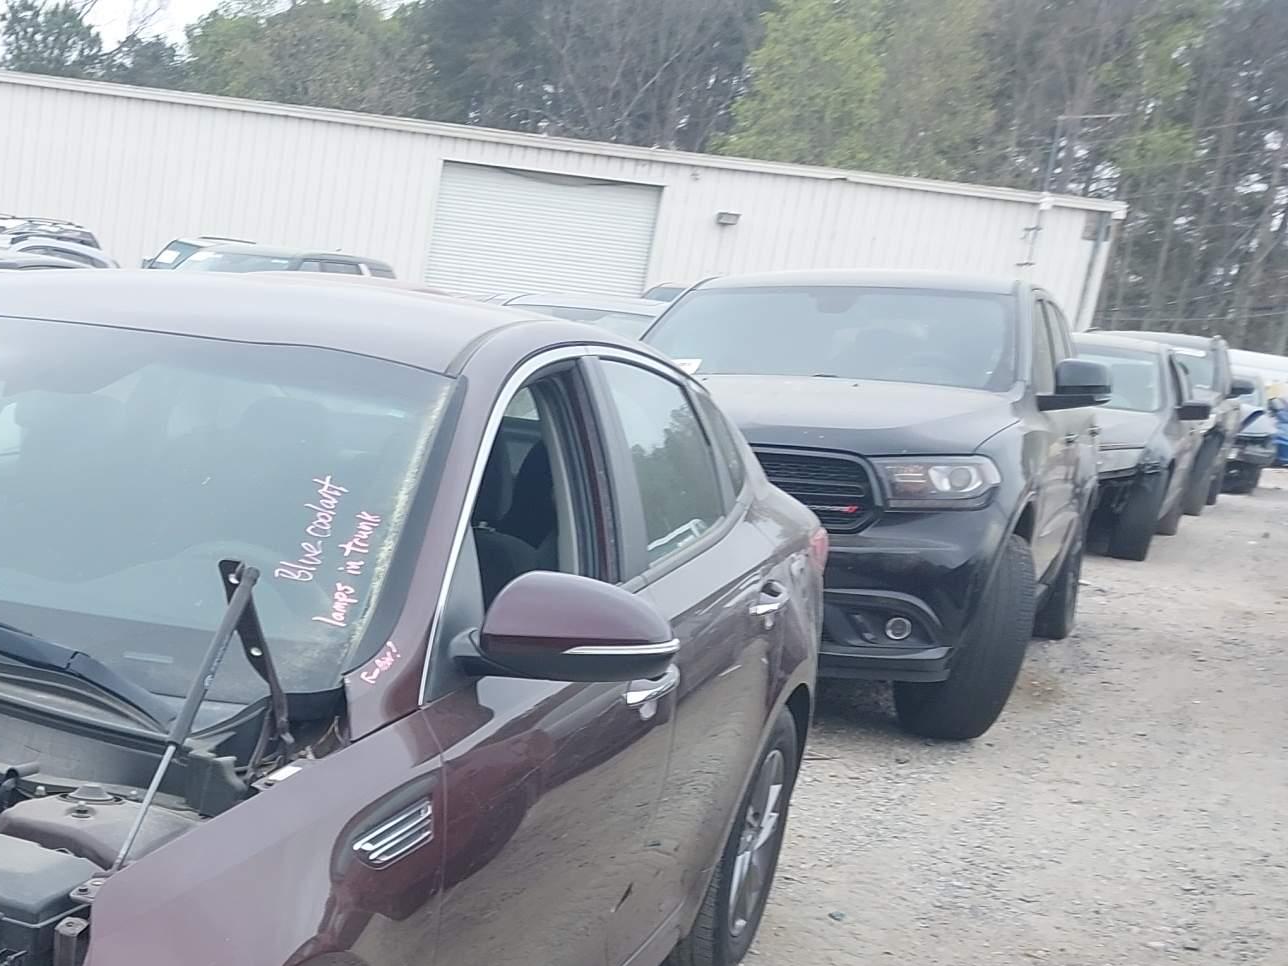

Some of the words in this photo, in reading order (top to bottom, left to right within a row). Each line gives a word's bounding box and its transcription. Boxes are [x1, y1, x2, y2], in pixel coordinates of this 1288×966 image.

[337, 511, 382, 557] trunk
[274, 540, 323, 581] Blue
[337, 560, 365, 576] in
[312, 582, 359, 627] lamps
